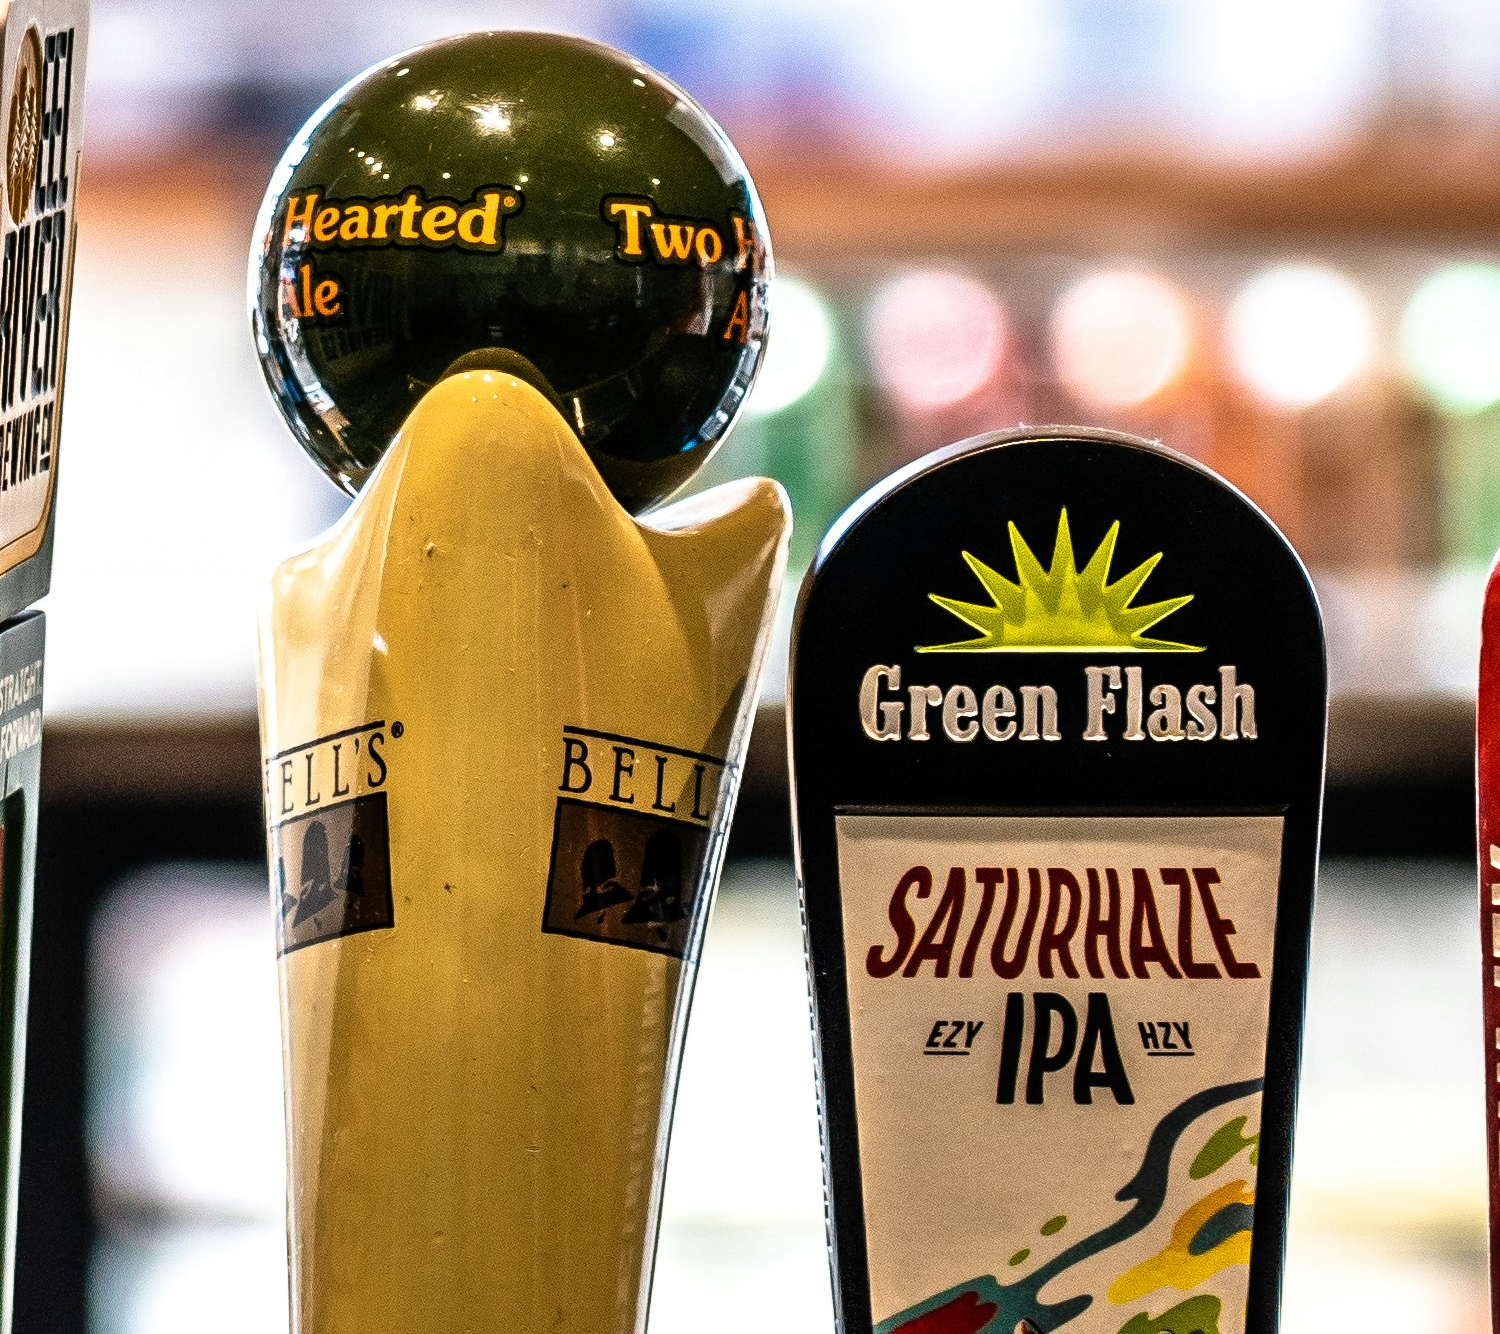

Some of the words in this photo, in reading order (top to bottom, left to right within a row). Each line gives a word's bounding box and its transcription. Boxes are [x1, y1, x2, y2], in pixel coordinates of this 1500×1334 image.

[611, 203, 722, 265] Two
[859, 664, 1061, 742] Green
[1083, 664, 1259, 742] Flash
[865, 865, 1262, 980] SATURHAZE
[923, 1020, 984, 1055] EZY
[995, 991, 1136, 1105] IPA
[1138, 1021, 1195, 1056] HZY
